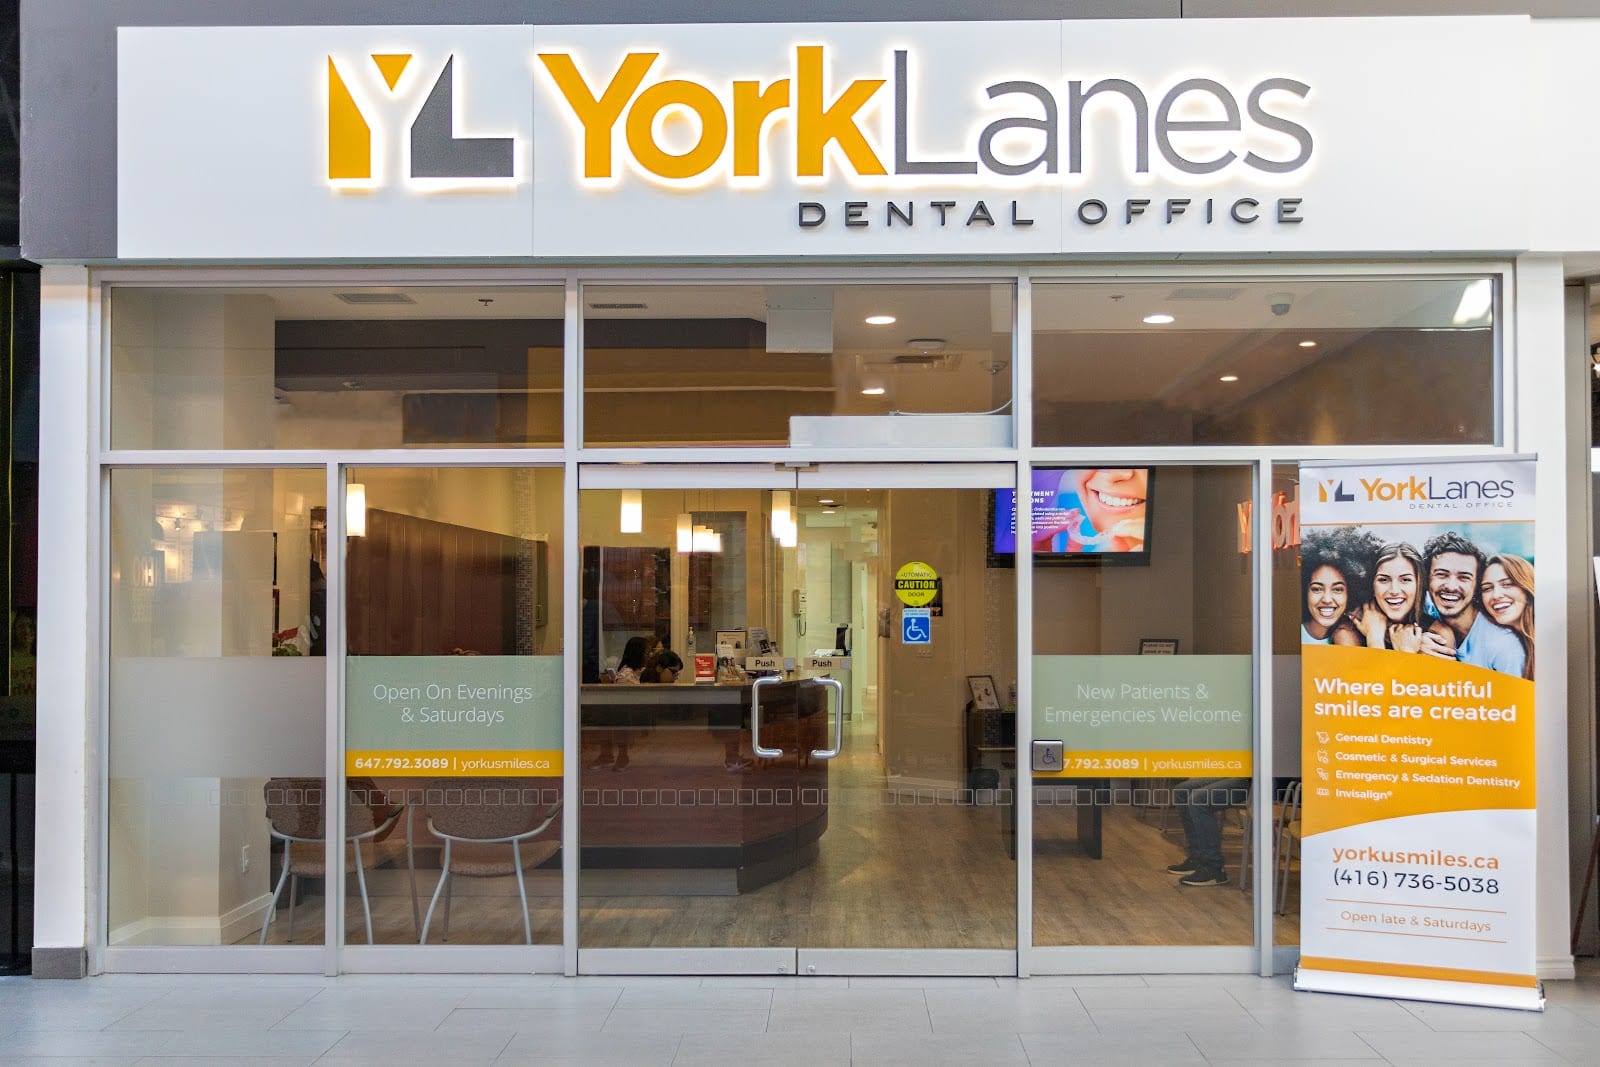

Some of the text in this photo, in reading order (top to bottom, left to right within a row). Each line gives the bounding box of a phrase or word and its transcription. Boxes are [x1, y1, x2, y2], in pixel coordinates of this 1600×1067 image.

[537, 46, 1314, 180] YorkLanes
[799, 197, 1304, 227] DENTAL OFFICE
[1359, 475, 1515, 502] YorkLanes
[1465, 501, 1514, 509] OFFICE
[897, 580, 936, 590] CAUTION
[754, 659, 776, 669] Push
[811, 659, 833, 669] Push
[373, 684, 534, 704] Open On Evenings
[1077, 683, 1209, 700] New Patients &
[1314, 677, 1493, 699] Where beautiful
[401, 707, 505, 727] & Saturdays
[1045, 706, 1241, 727] Emergencies Welcome
[1314, 700, 1517, 722] smiles are created
[1334, 732, 1433, 747] General Dentistry
[355, 757, 550, 772] 647.792.3089 yorkusmiles.ca
[1063, 758, 1242, 772] 7.792.3089 yorkusmiles.ca
[1334, 751, 1498, 768] Cosmetic & Surgical Services
[1335, 770, 1521, 789] Emergency & Sedation Dentistry
[1332, 846, 1500, 870] yorkusmiles.ca
[1333, 867, 1500, 895] (416) 736-5038
[1340, 910, 1492, 933] Open late & Saturdays
